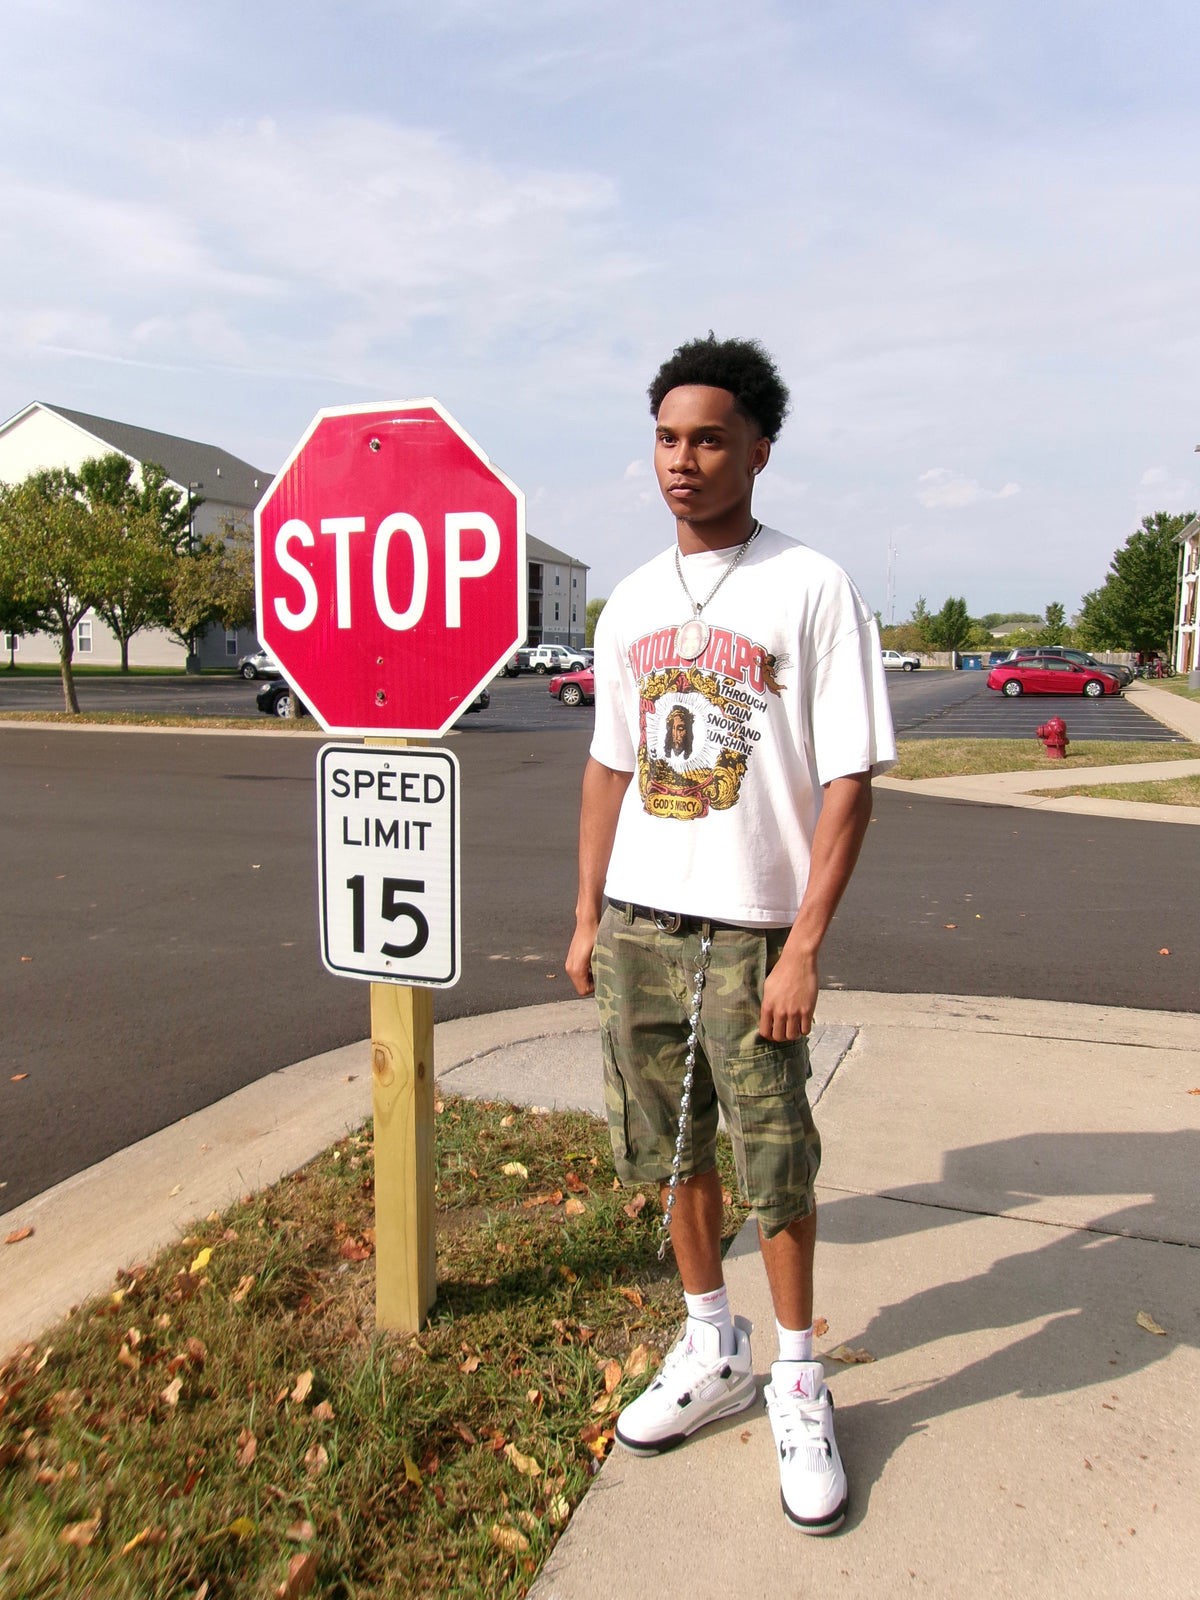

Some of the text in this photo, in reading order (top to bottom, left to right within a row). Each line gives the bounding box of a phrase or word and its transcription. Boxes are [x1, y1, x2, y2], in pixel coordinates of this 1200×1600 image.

[273, 511, 501, 631] STOP
[720, 685, 768, 713] THROUGH
[726, 704, 753, 722] RAIN
[706, 713, 761, 741] SNOW AND
[331, 768, 445, 803] SPEED
[653, 798, 697, 812] GOD'S MERCY
[343, 816, 432, 851] LIMIT
[346, 874, 429, 959] 15
